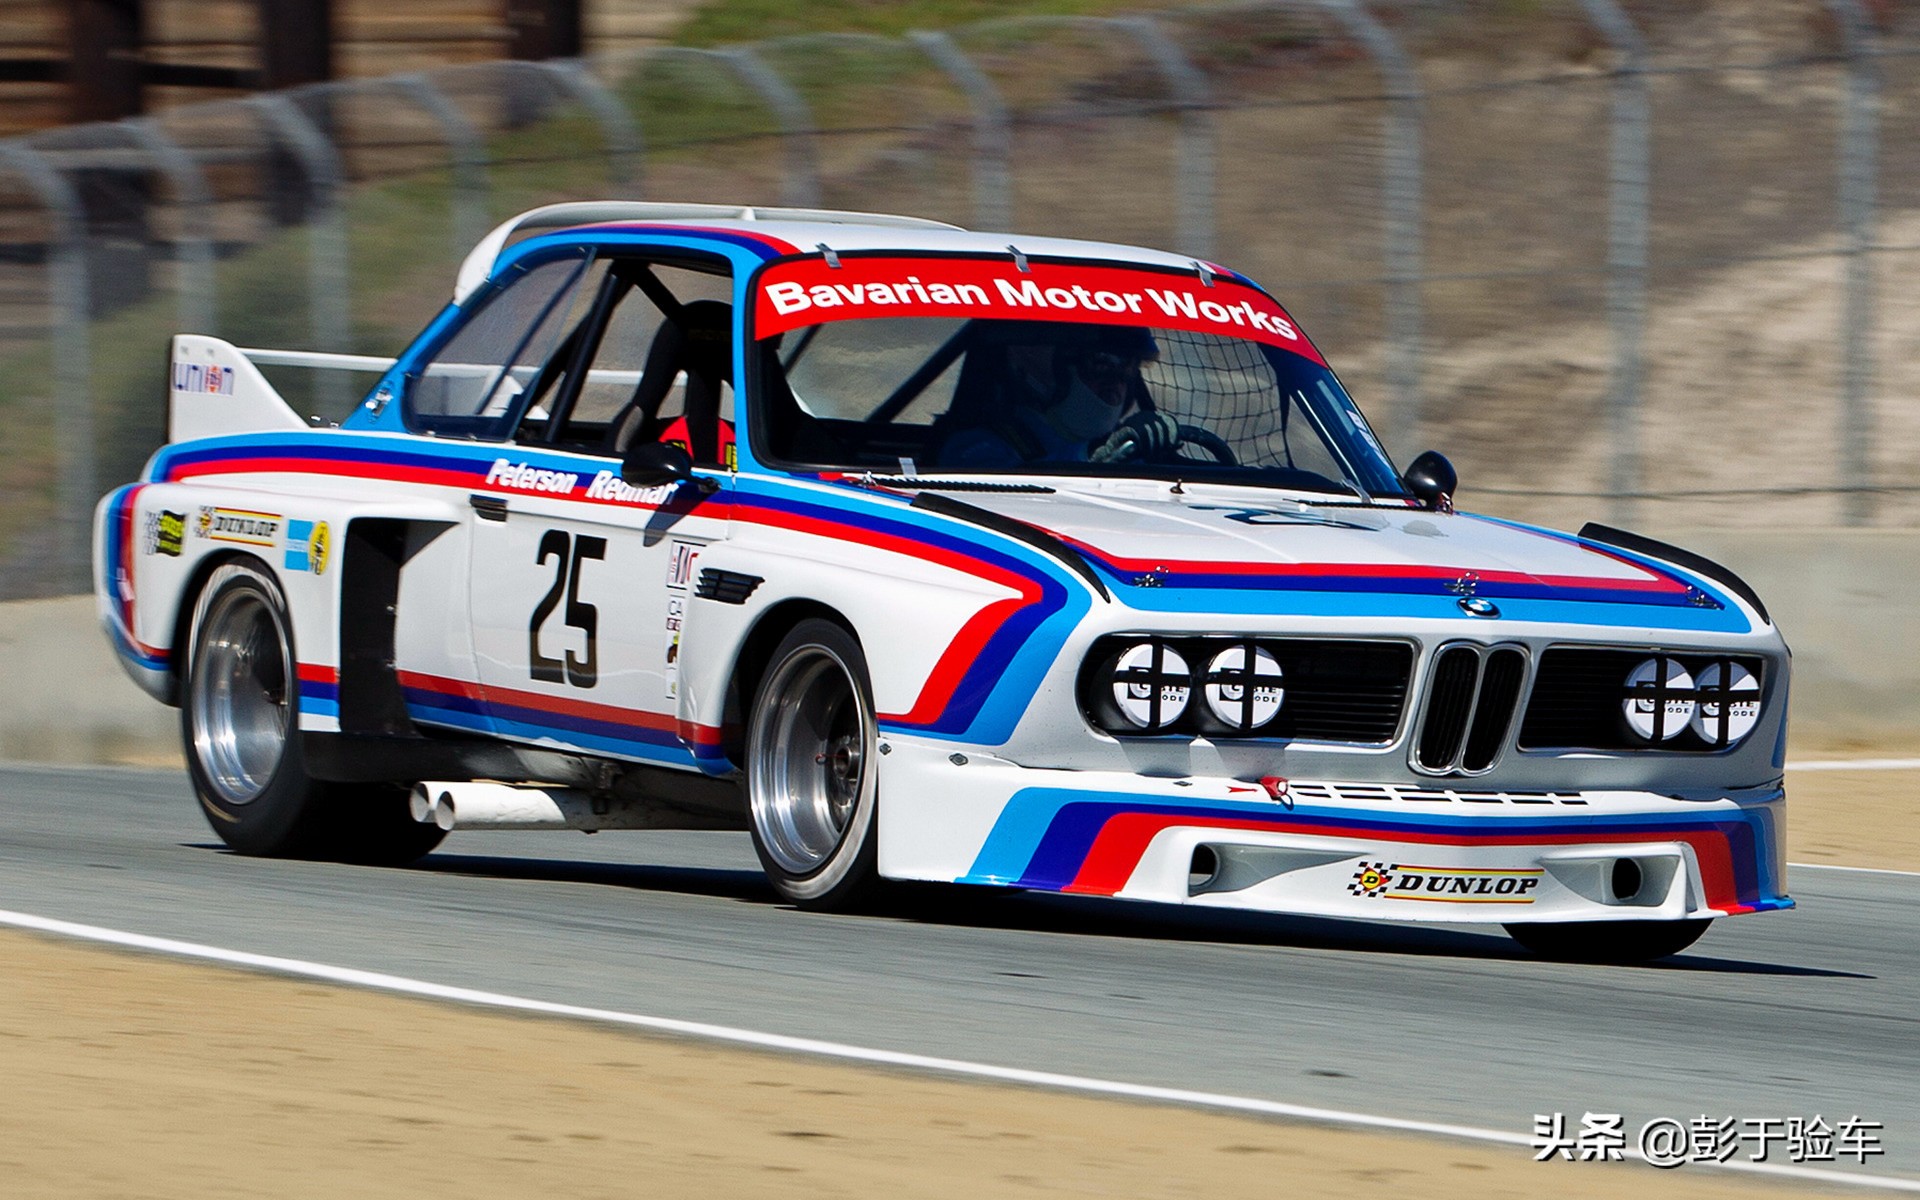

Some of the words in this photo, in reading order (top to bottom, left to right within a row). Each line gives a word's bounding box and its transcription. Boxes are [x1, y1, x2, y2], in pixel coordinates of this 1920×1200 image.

[765, 276, 991, 316] Bavarian
[993, 278, 1143, 314] Motor
[1144, 288, 1298, 341] Works
[485, 457, 579, 495] Peterson
[214, 516, 279, 537] DUNLOP
[530, 529, 607, 689] 25
[1395, 874, 1539, 895] DUNLOP
